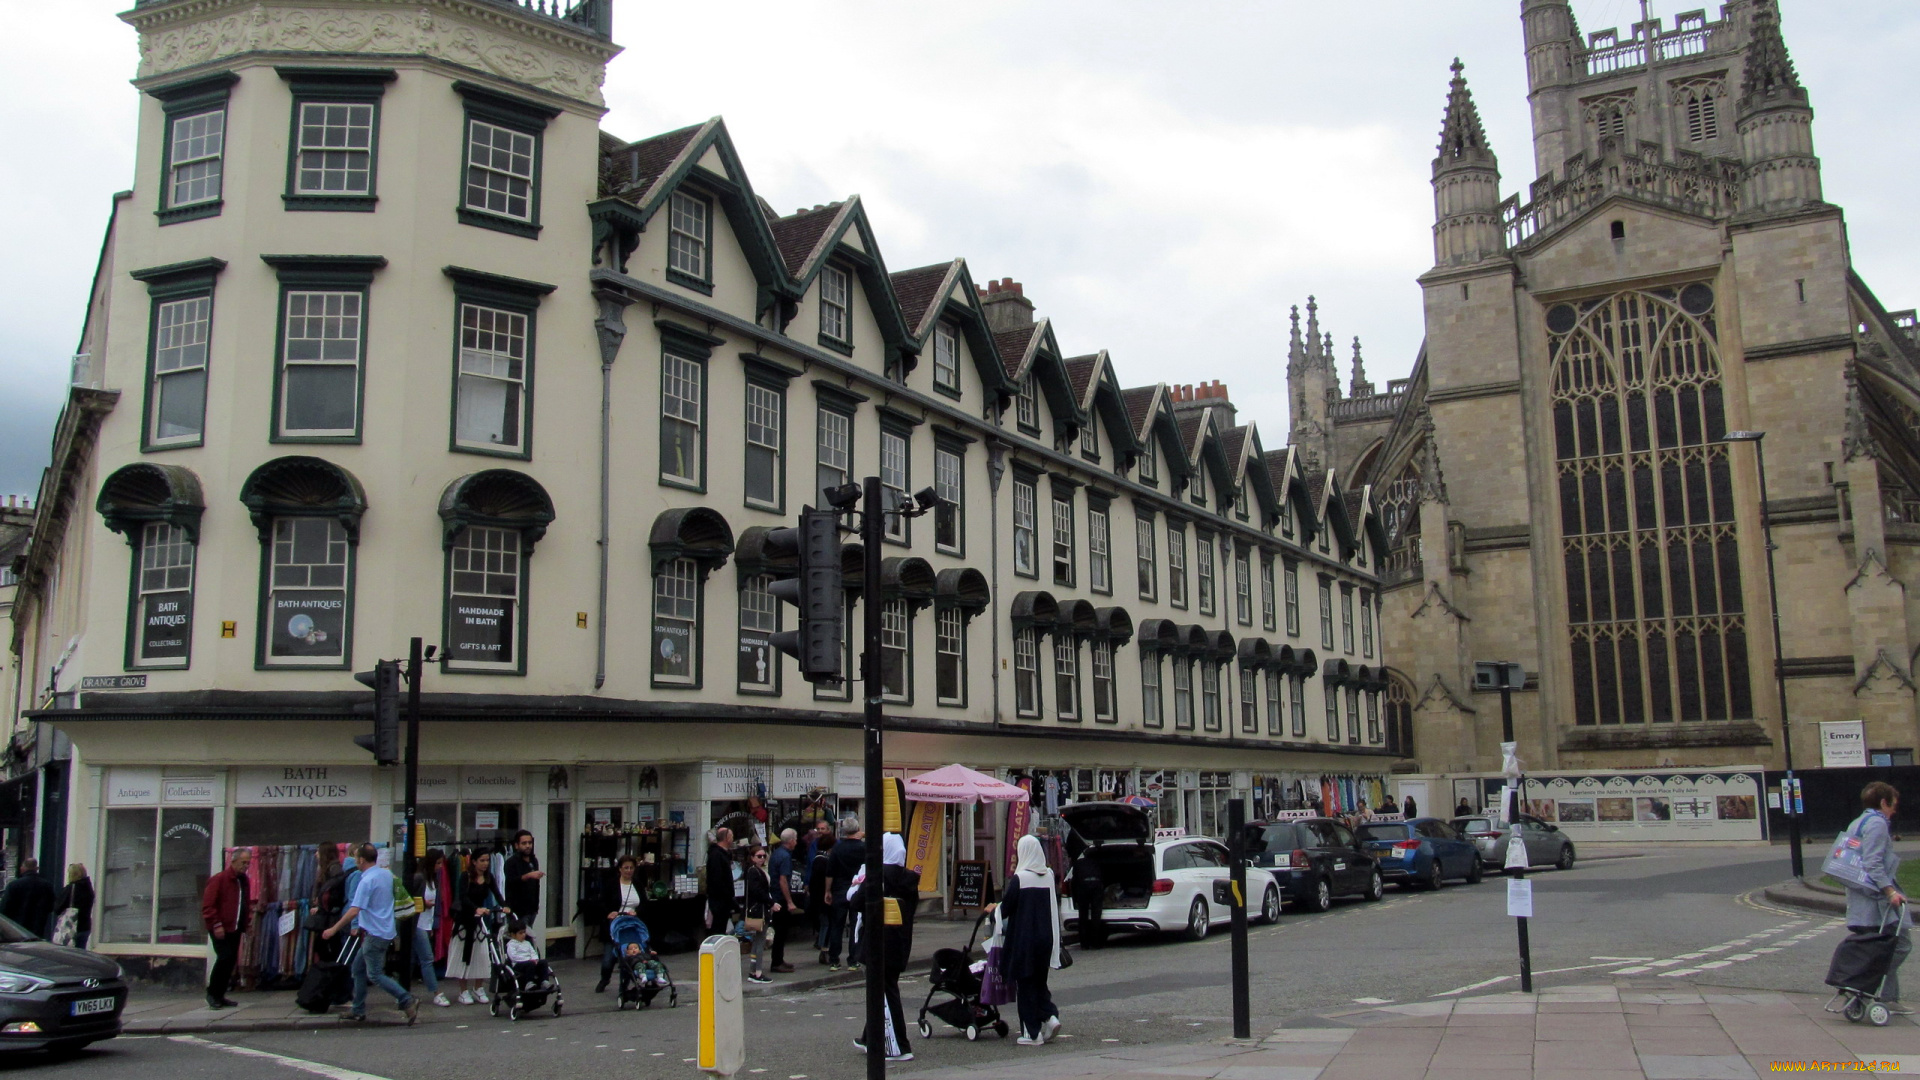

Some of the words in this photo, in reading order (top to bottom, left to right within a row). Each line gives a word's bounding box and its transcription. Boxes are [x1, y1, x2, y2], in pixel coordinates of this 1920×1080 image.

[158, 602, 178, 612] BATH
[278, 600, 300, 608] BATH
[301, 600, 342, 609] ANTIQUES
[458, 607, 504, 616] HANDMADE
[149, 615, 186, 626] ANTIQUES
[465, 617, 474, 625] IN
[476, 617, 497, 626] BATH
[221, 621, 235, 638] H
[667, 627, 688, 636] ANTIQUES
[149, 639, 182, 648] COLLECTABLES
[460, 642, 480, 651] GIFTS
[487, 643, 502, 651] ART
[82, 677, 116, 687] ORANGE
[120, 676, 145, 686] GROVE
[1829, 732, 1861, 740] Emery
[284, 767, 328, 780] BATH
[785, 768, 795, 778] BY
[796, 768, 816, 778] BATH
[416, 776, 447, 787] tiques
[467, 776, 516, 785] Collectibles
[167, 786, 211, 796] Collectibles
[262, 785, 348, 800] ANTIQUES
[724, 783, 733, 793] IN
[782, 782, 818, 793] ARTISANS
[117, 788, 150, 798] Antiques
[407, 807, 414, 816] 2
[777, 810, 799, 828] HANDMA
[164, 823, 192, 838] VINTAGE
[192, 823, 210, 838] ITEMS
[916, 801, 937, 860] GELATO
[1155, 830, 1177, 838] AXI
[76, 1000, 98, 1012] YN65
[100, 998, 113, 1010] LKX
